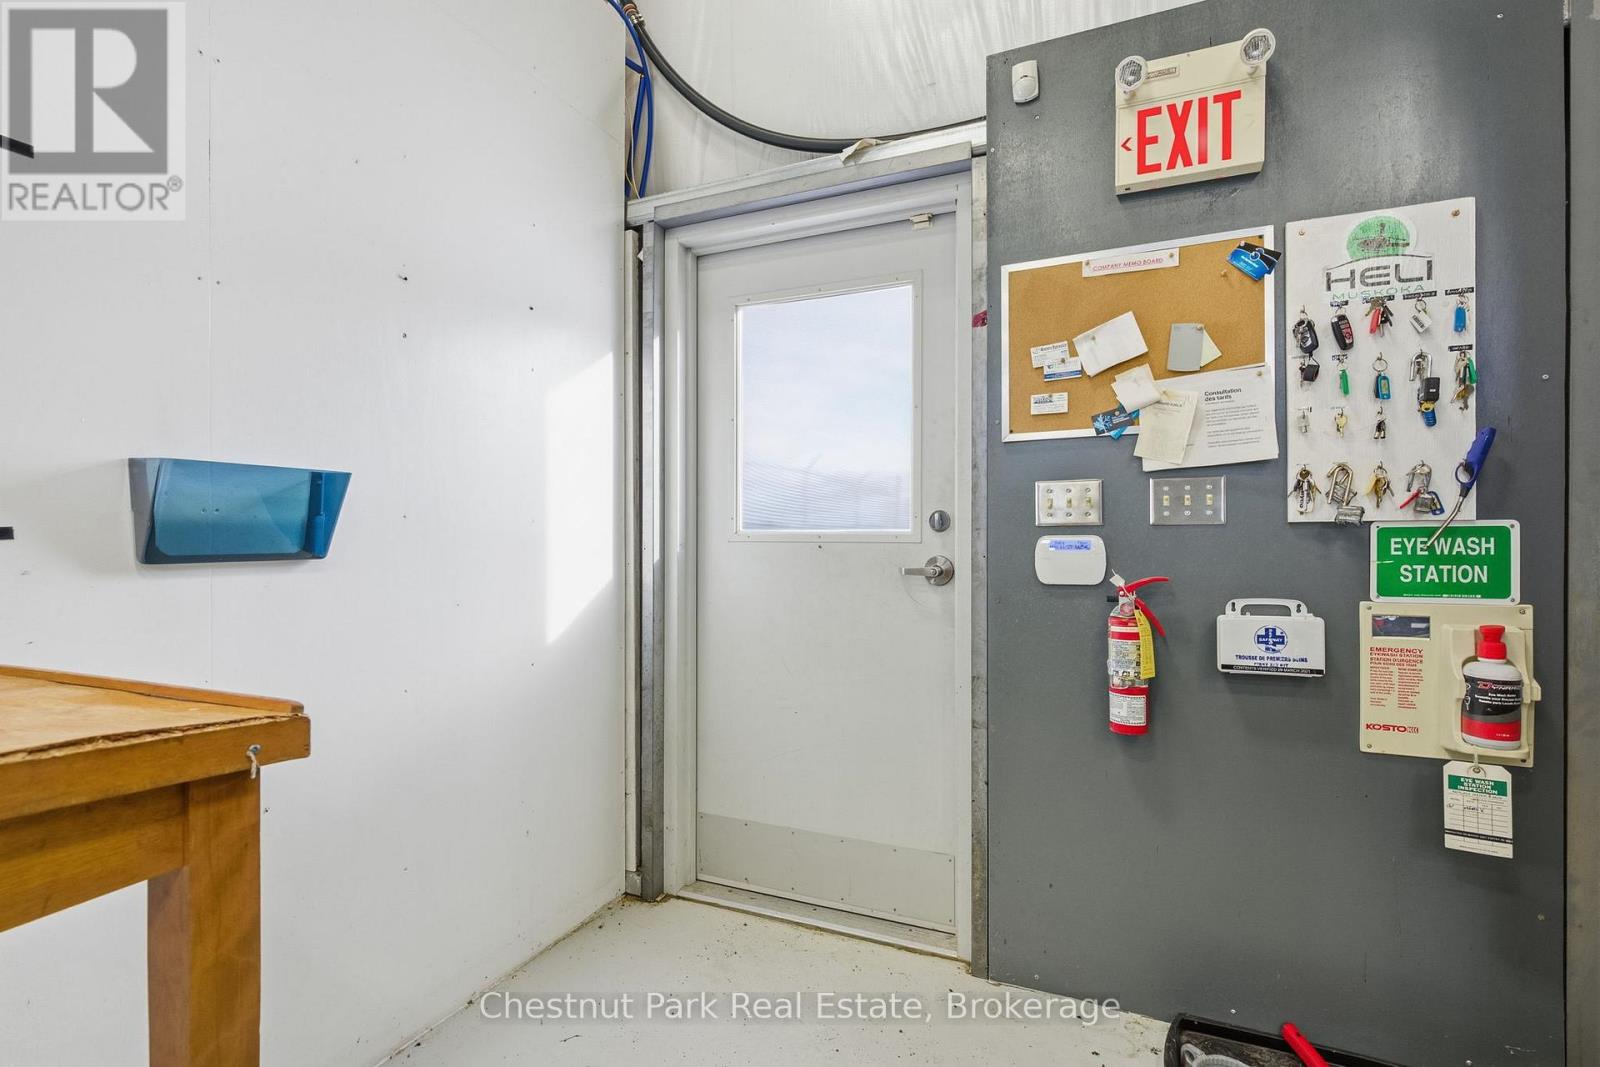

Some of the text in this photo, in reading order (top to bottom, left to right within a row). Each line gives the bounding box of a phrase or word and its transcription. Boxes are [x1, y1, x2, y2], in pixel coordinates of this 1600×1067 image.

[1136, 89, 1242, 175] EXIT
[1092, 257, 1163, 272] COMPANY MEMO BOARD
[1325, 260, 1433, 292] HELI
[1332, 284, 1425, 301] MUSKOKA
[1204, 388, 1242, 397] Consultation
[1390, 537, 1496, 556] EYE WASH
[1399, 564, 1488, 584] STATION
[1369, 646, 1424, 654] EMERGENCY
[1457, 785, 1498, 794] INSPECTION
[1463, 782, 1492, 790] STATION
[1474, 778, 1495, 786] WASH
